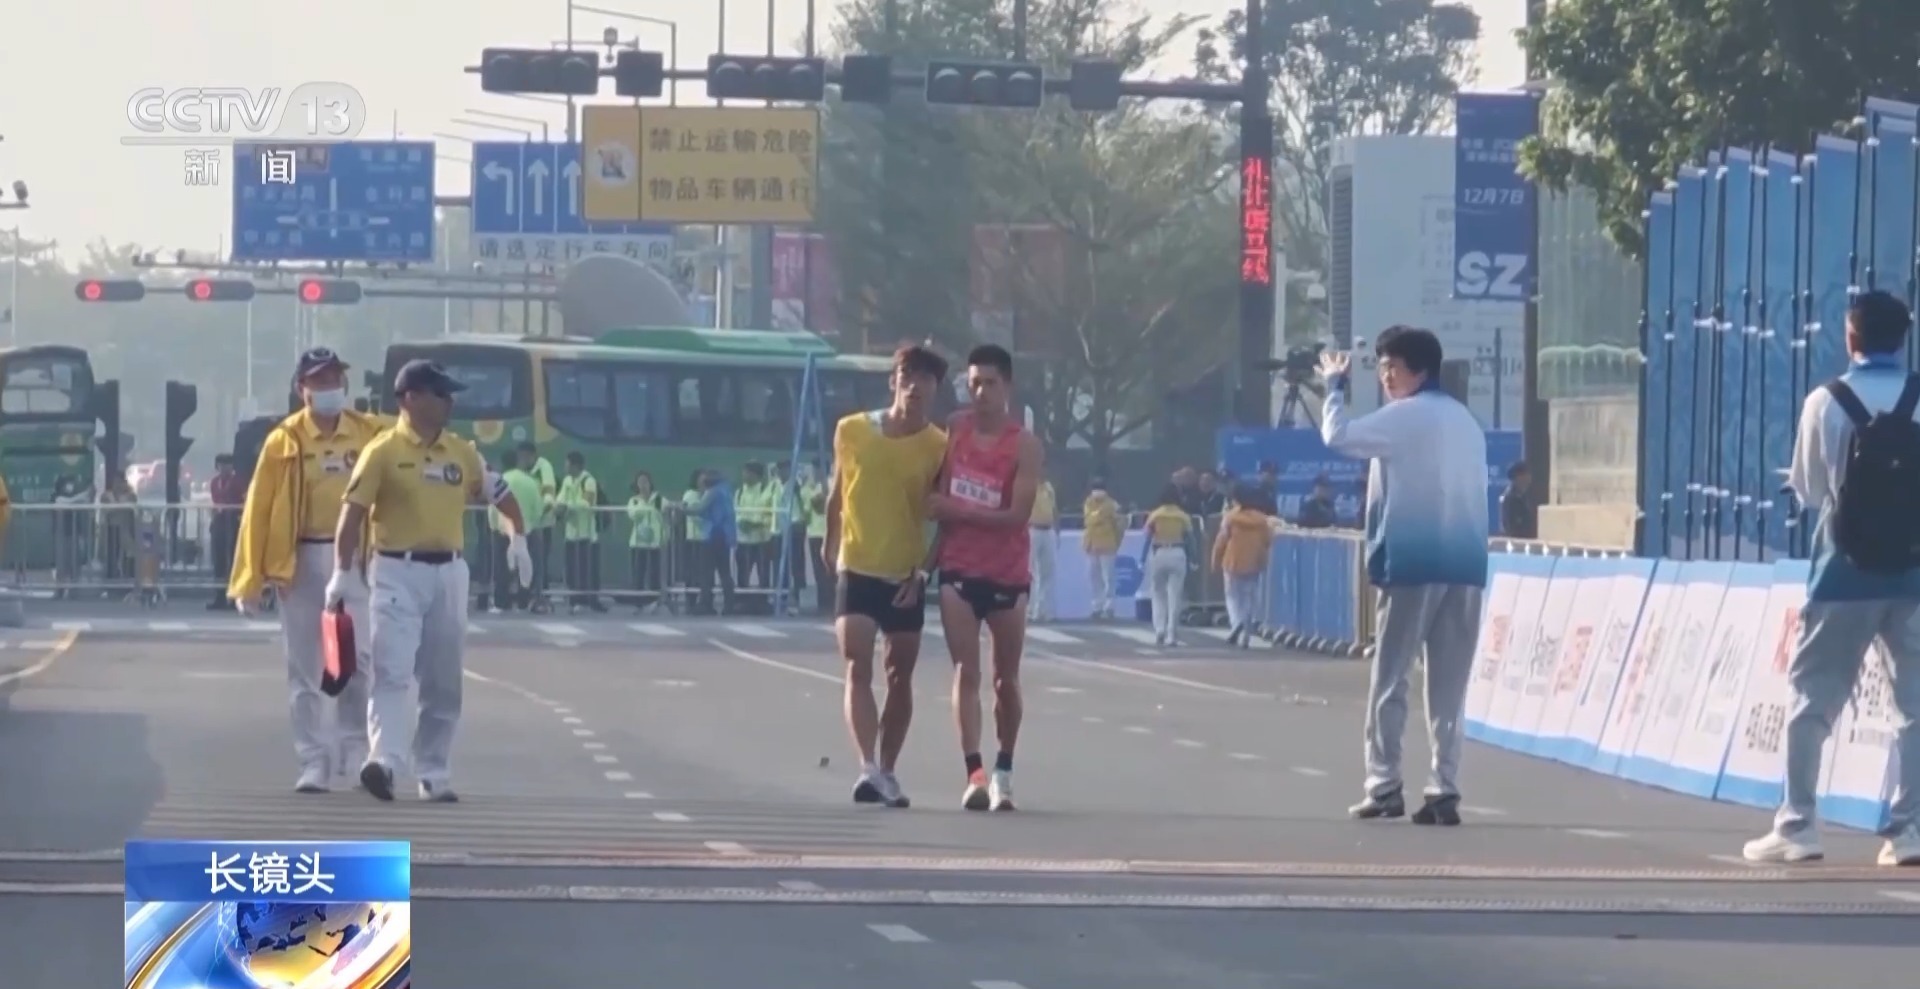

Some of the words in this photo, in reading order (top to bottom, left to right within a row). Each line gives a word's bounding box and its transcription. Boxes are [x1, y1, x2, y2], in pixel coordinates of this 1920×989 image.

[651, 127, 812, 152] 禁止运输危险
[650, 176, 810, 201] 物品车辆通行
[1464, 187, 1525, 205] 12月7日
[1456, 251, 1527, 296] SZ
